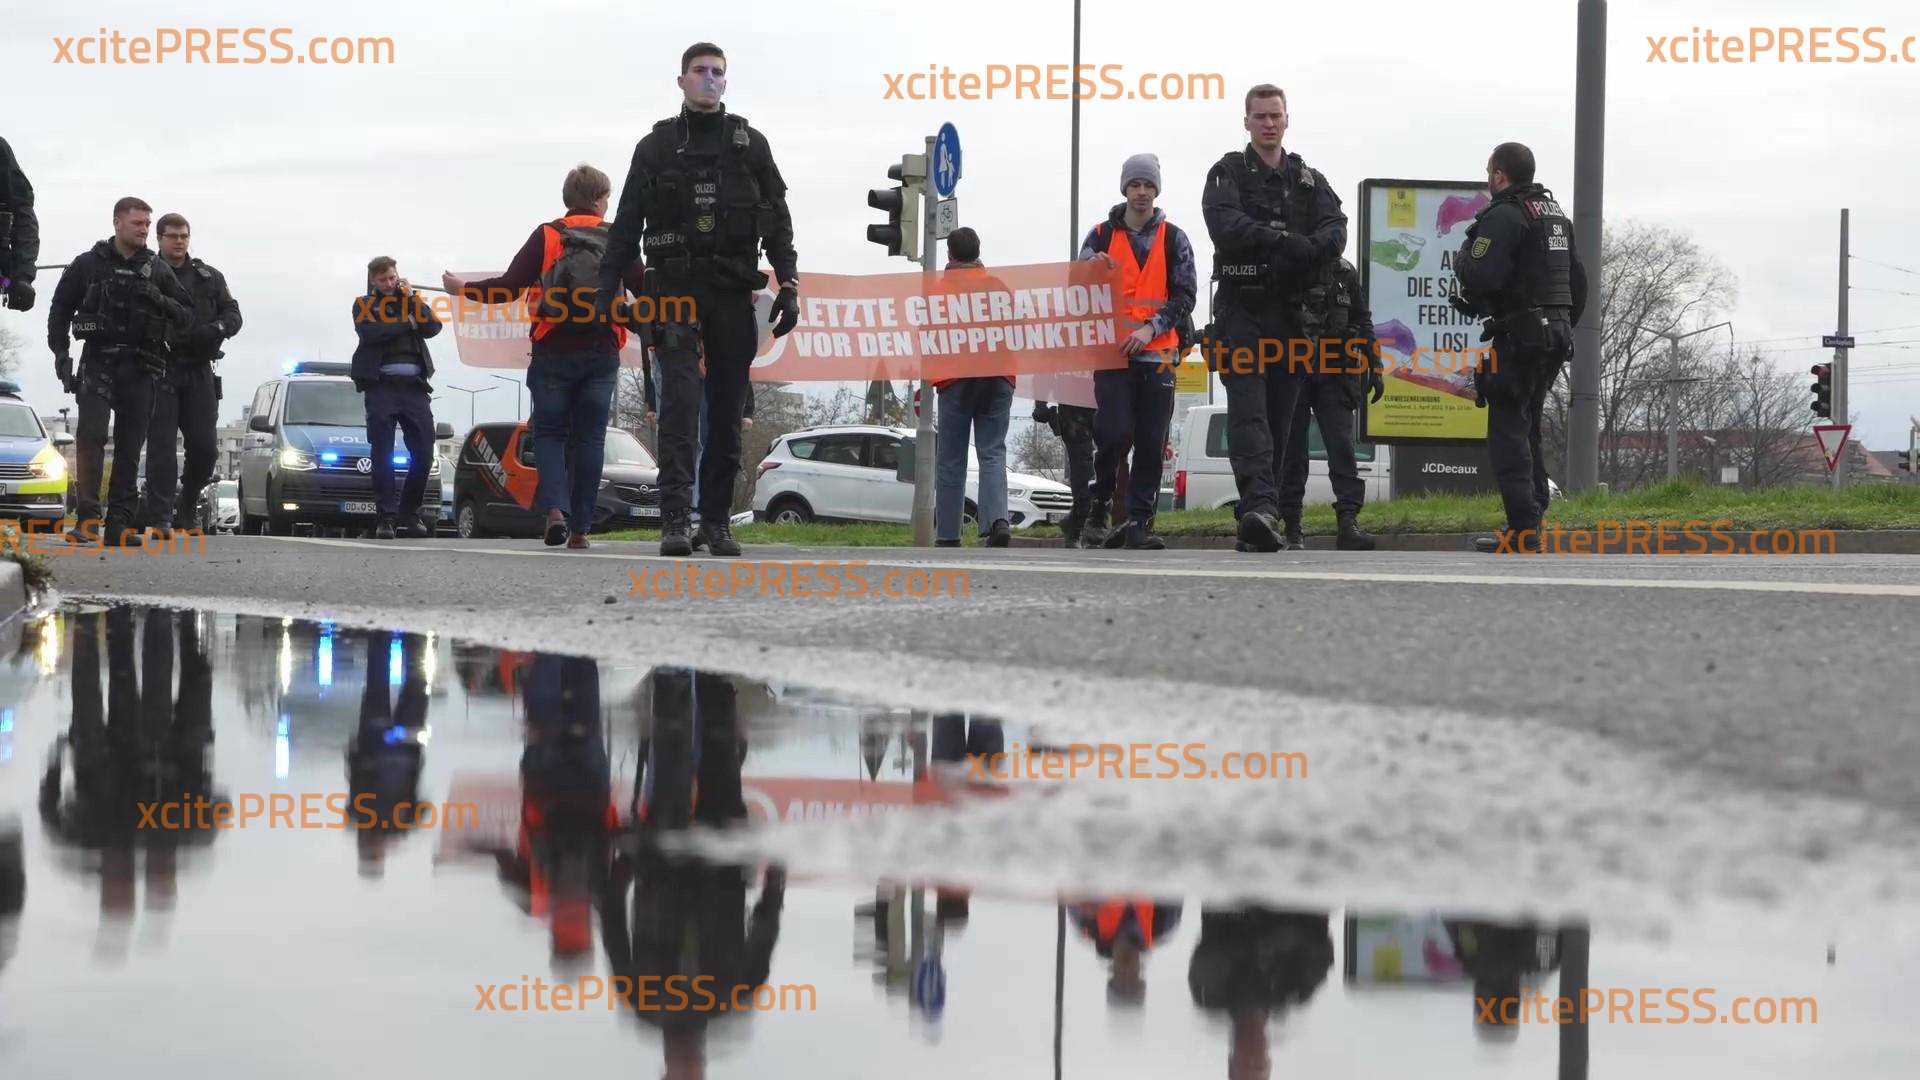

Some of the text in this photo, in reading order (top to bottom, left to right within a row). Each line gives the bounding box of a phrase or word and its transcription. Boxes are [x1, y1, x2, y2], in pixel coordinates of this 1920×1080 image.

[646, 233, 675, 246] POLIZEI
[1552, 224, 1563, 235] SN
[1440, 250, 1457, 270] A
[1222, 265, 1257, 276] POLIZEI
[1407, 276, 1433, 297] DIE
[797, 284, 1114, 327] LETZTE GENERATION
[793, 319, 1117, 357] VOR DEN KIPPPUNKTEN
[1433, 332, 1469, 352] LOS!
[1421, 463, 1478, 474] JCDecaux
